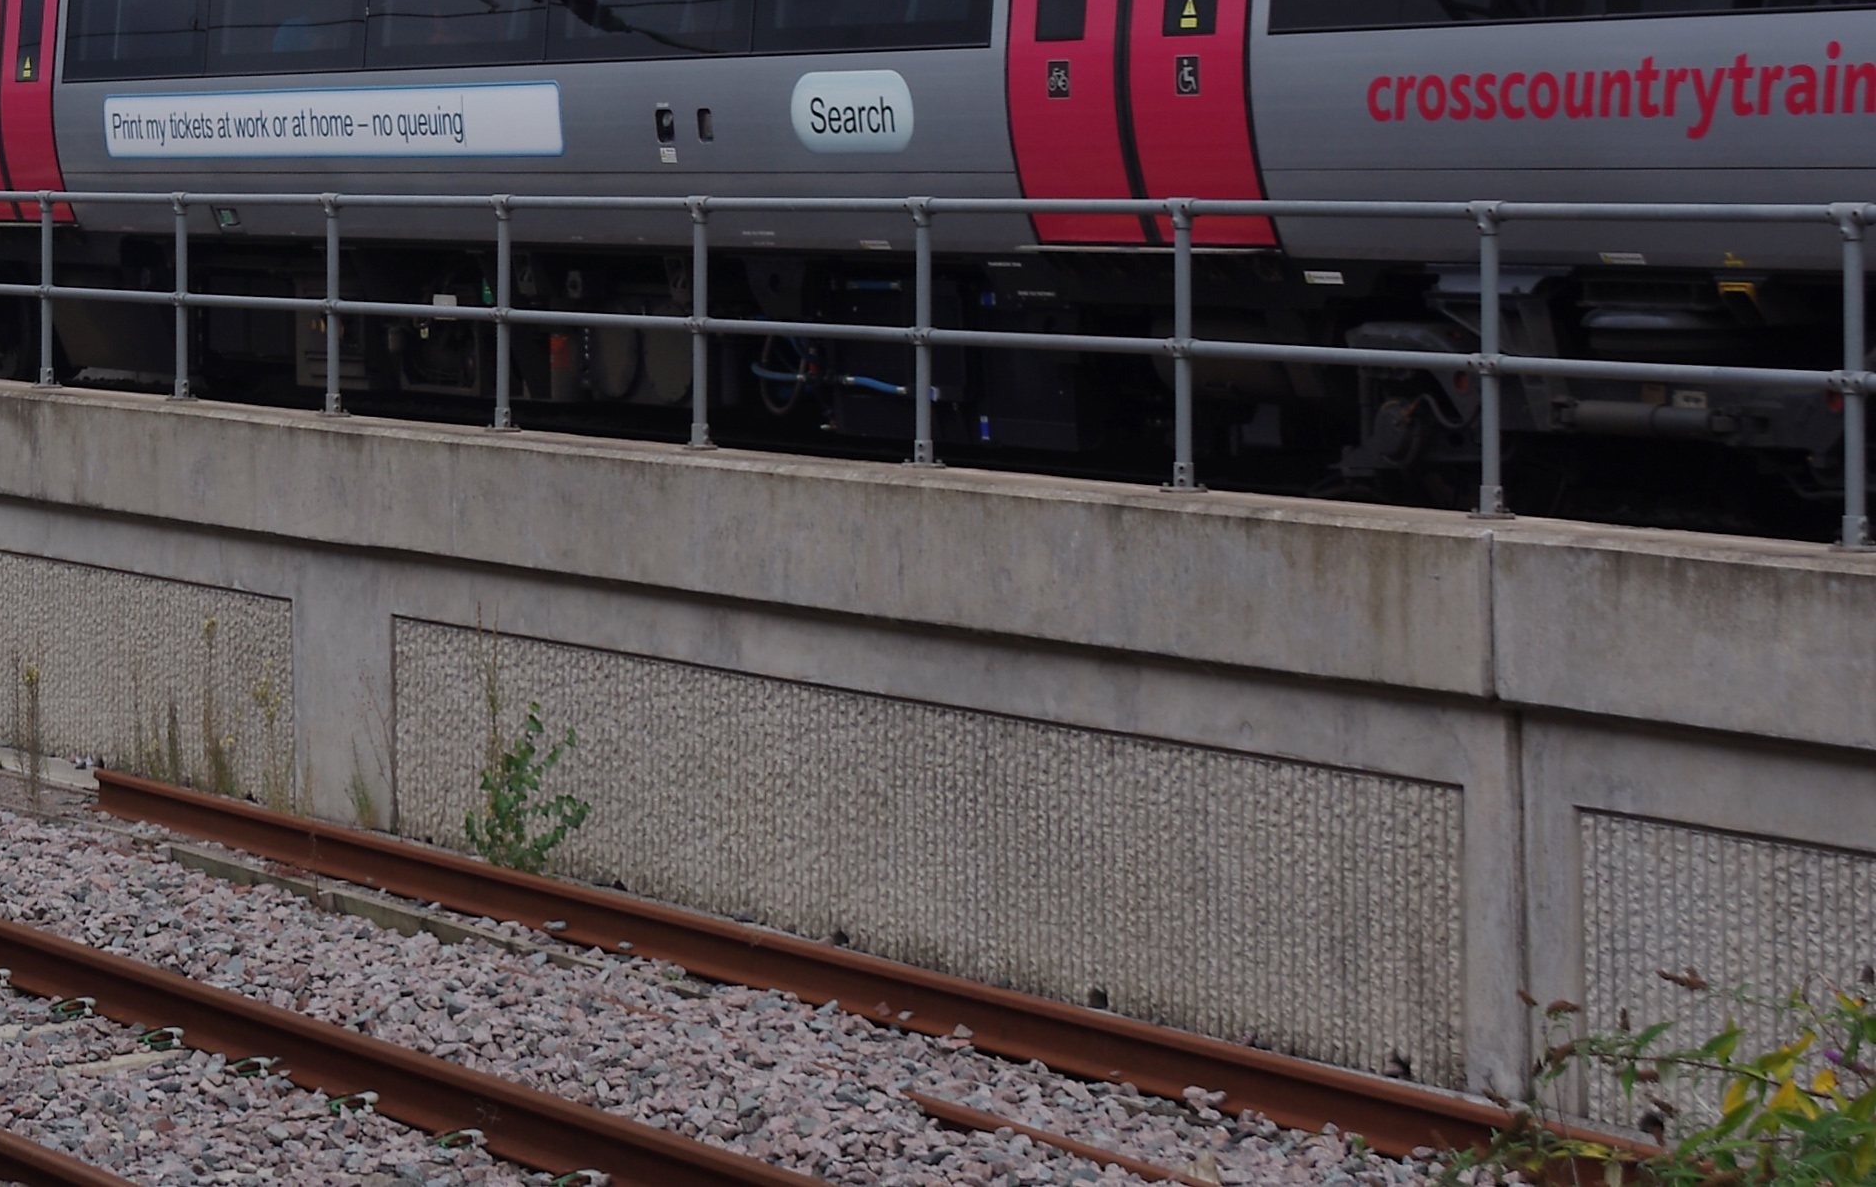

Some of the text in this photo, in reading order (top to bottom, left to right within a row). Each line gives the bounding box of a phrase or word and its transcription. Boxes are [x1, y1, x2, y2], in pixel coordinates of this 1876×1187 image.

[1366, 40, 1876, 140] crosscountrytrain
[112, 112, 143, 140] Print
[146, 117, 166, 147] my
[169, 111, 214, 139] tickets
[218, 111, 232, 139] at
[233, 110, 269, 139] work
[274, 115, 288, 138] or
[292, 109, 307, 137] at
[309, 108, 354, 137] home
[372, 114, 393, 137] no
[397, 105, 465, 144] queuing
[810, 96, 896, 134] Search
